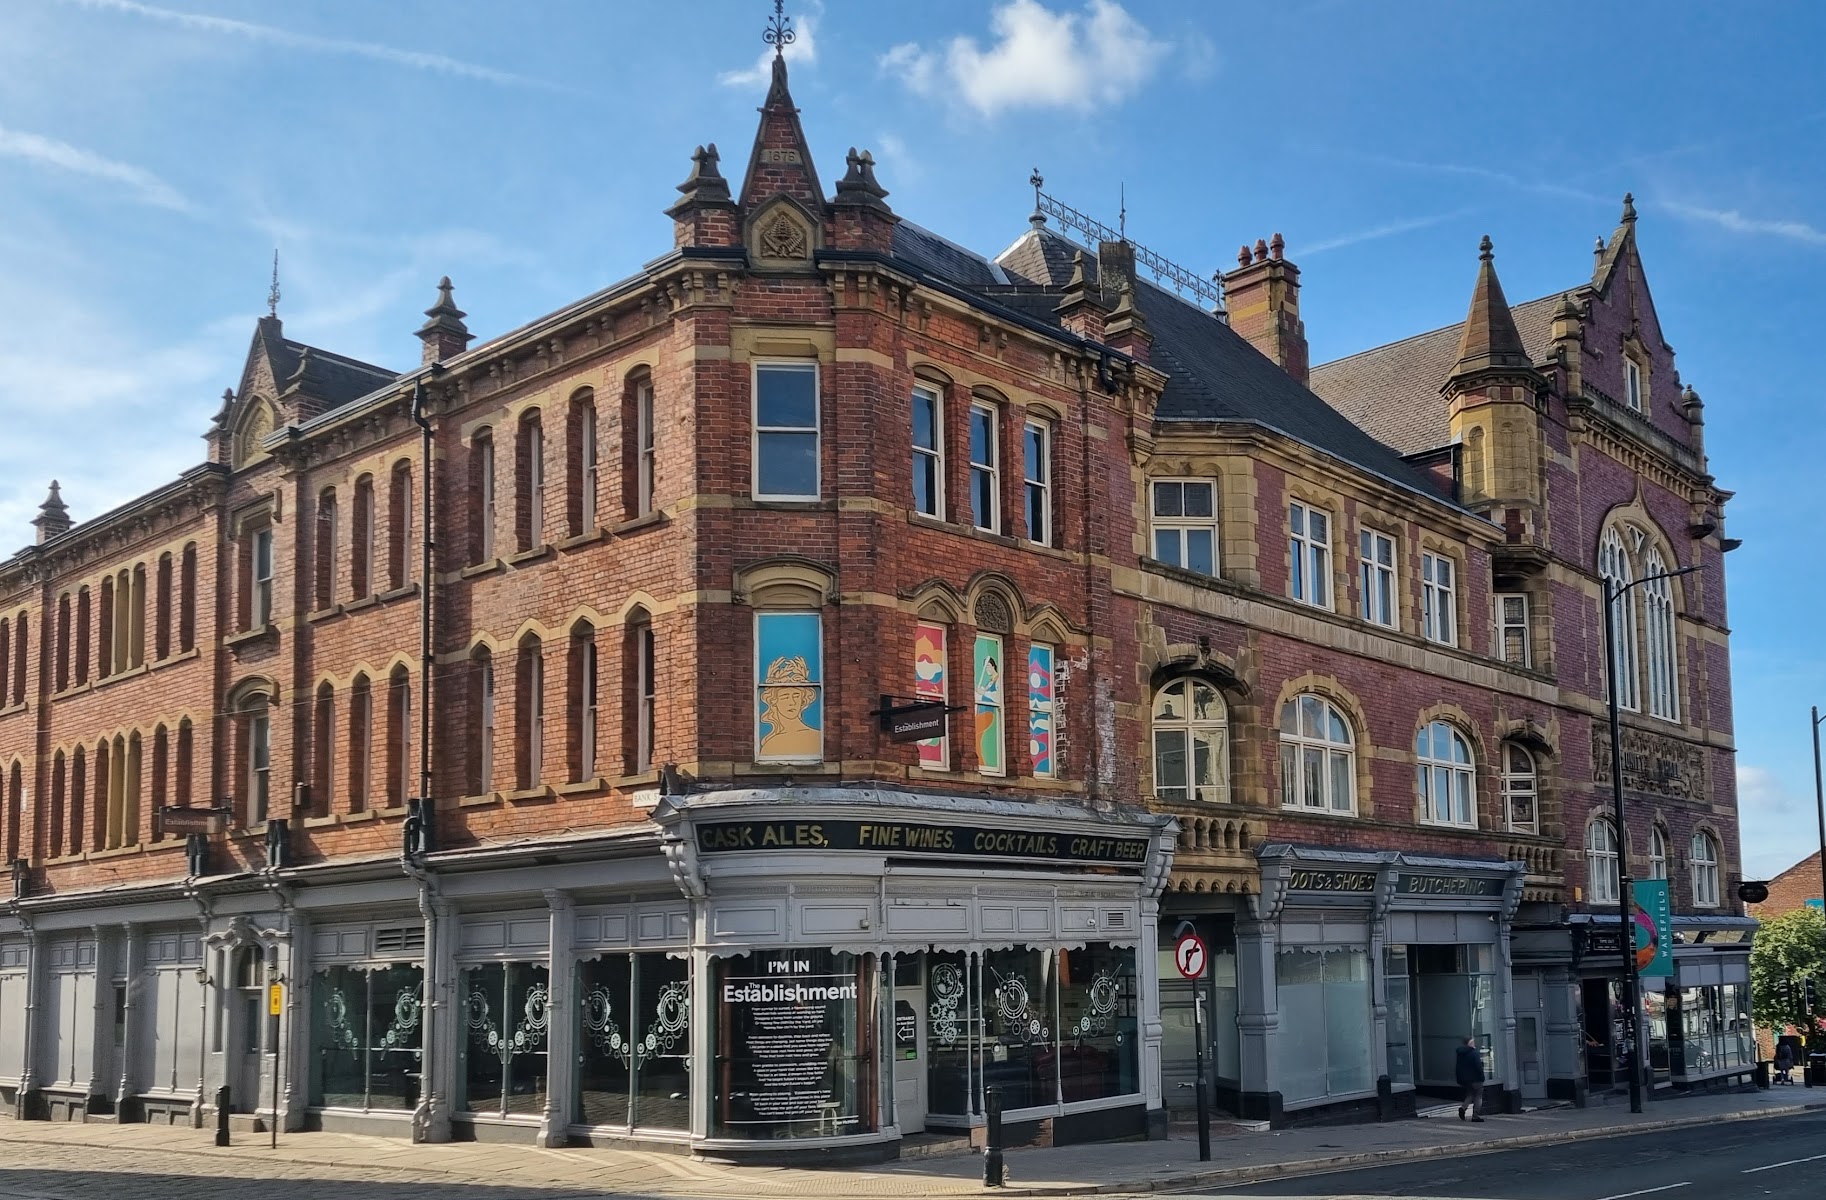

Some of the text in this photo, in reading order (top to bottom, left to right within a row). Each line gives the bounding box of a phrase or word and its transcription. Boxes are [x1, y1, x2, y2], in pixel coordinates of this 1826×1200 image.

[894, 719, 939, 734] Establishment
[634, 793, 652, 803] BANK
[701, 825, 1145, 859] CASK ALES, FINE WINES, COCKTAILS, CRAFT BEER
[1290, 871, 1325, 889] OOTS
[1333, 873, 1375, 890] SHOES
[1658, 890, 1668, 958] WAKEFIELD
[768, 960, 809, 973] I'M IN
[723, 982, 857, 1003] Establishment
